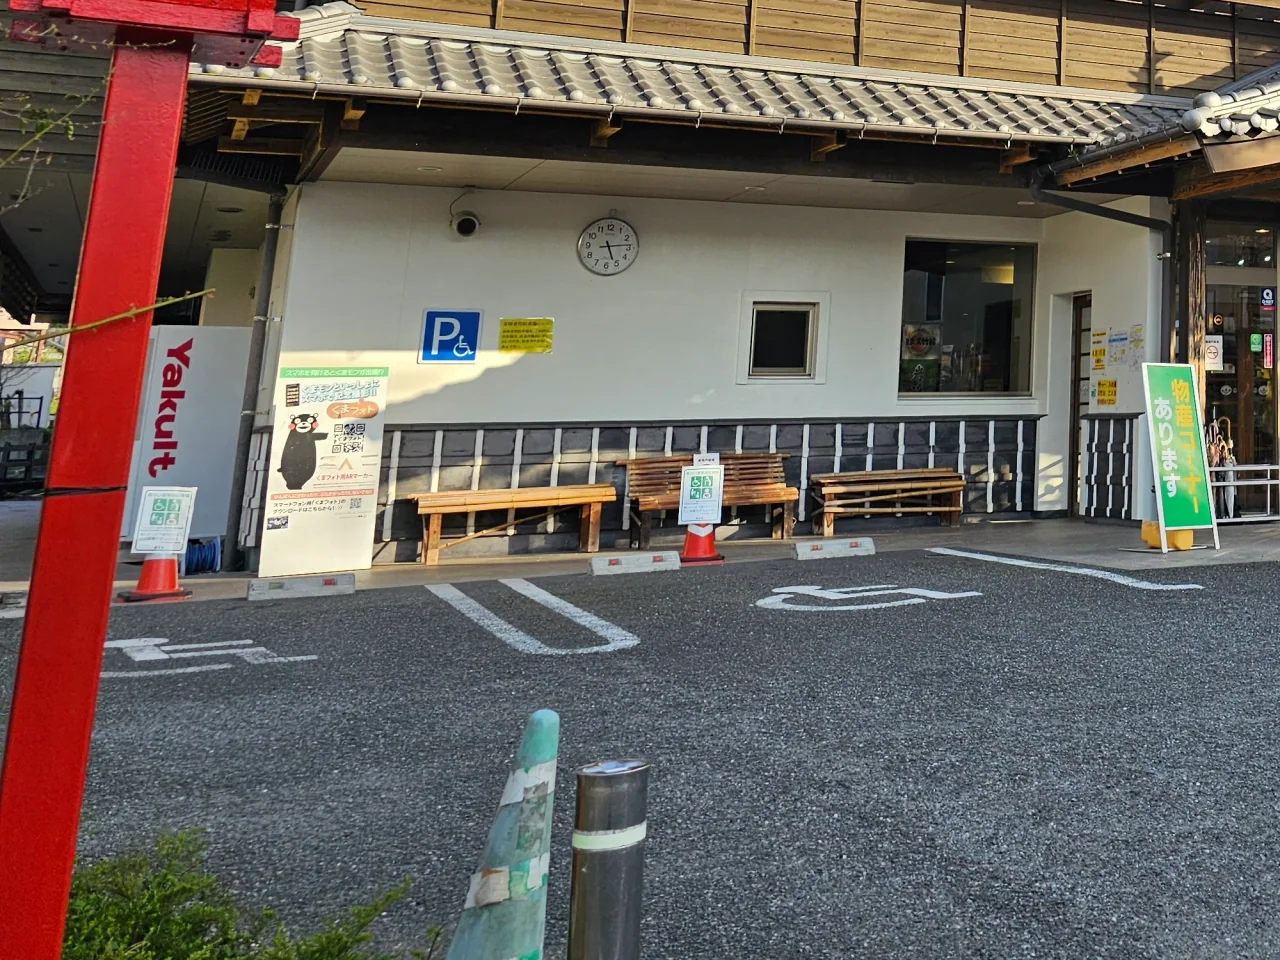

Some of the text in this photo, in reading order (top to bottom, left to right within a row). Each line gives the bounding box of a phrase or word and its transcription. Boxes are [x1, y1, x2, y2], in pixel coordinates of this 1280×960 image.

[431, 317, 460, 355] P
[148, 337, 194, 479] Yakult
[332, 405, 375, 415] くまフォト
[1154, 397, 1181, 498] あります
[1171, 379, 1201, 514] 物産コーナー
